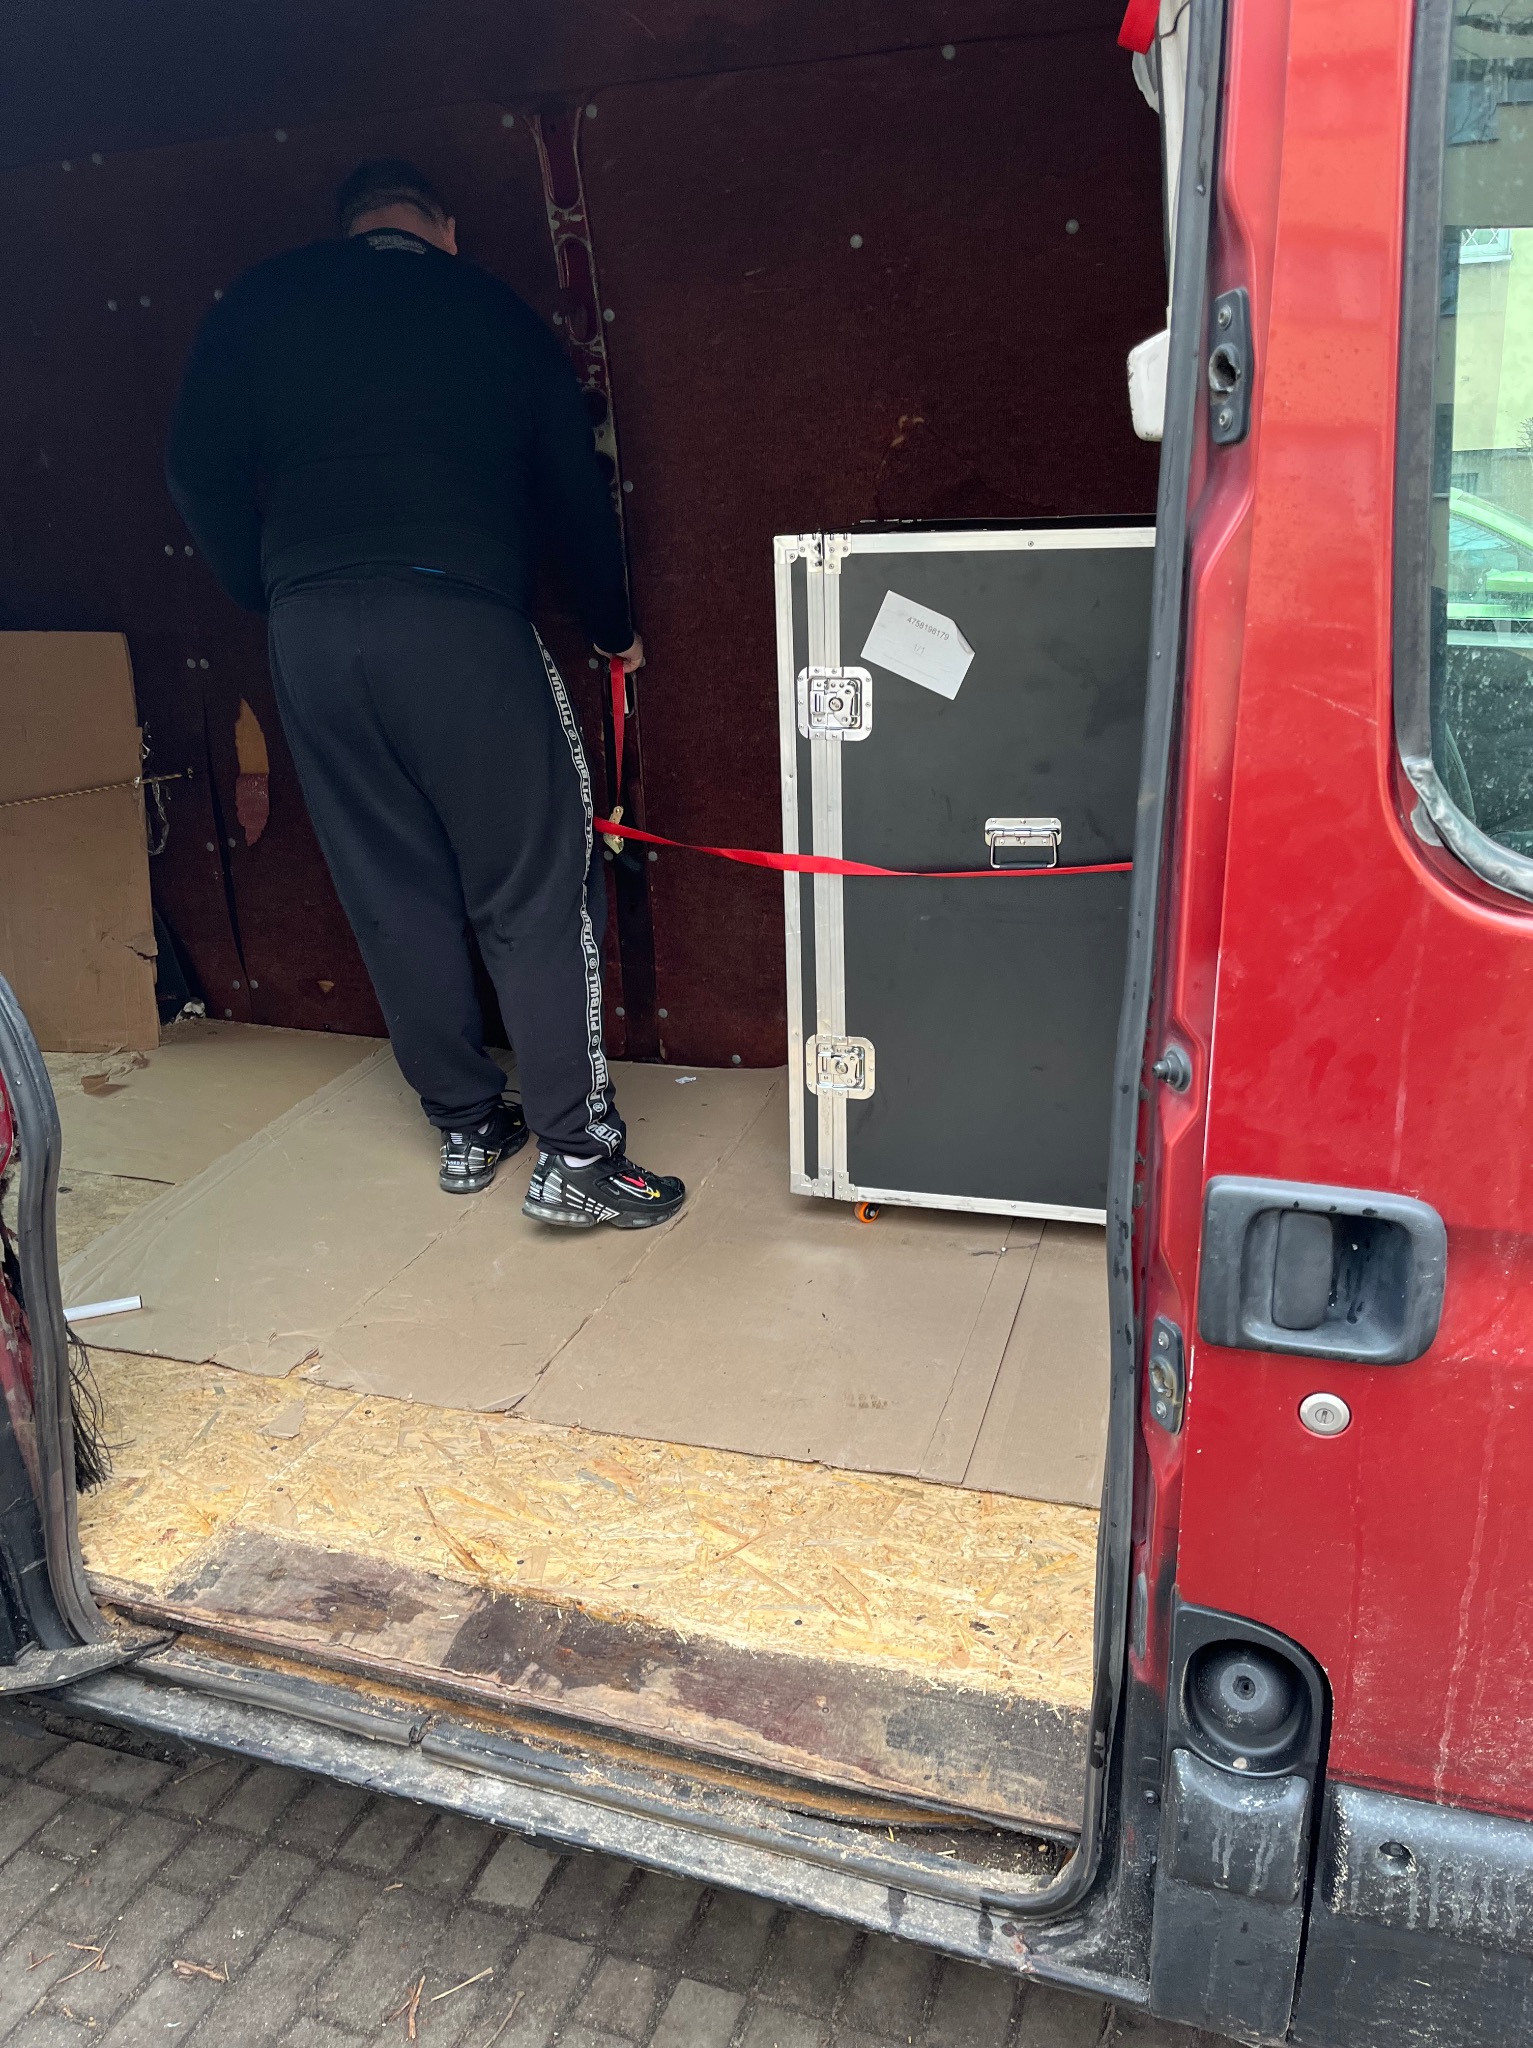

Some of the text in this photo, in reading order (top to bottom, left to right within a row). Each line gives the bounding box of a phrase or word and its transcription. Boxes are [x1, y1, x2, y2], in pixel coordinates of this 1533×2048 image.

[906, 616, 950, 641] 4758196179
[549, 665, 571, 726] PITBULL
[573, 744, 590, 802] PITBULL
[581, 910, 597, 954] PITBUL
[589, 973, 600, 1032] PITBULL
[589, 1049, 607, 1101] PTBULL
[587, 1123, 621, 1150] PITBU
